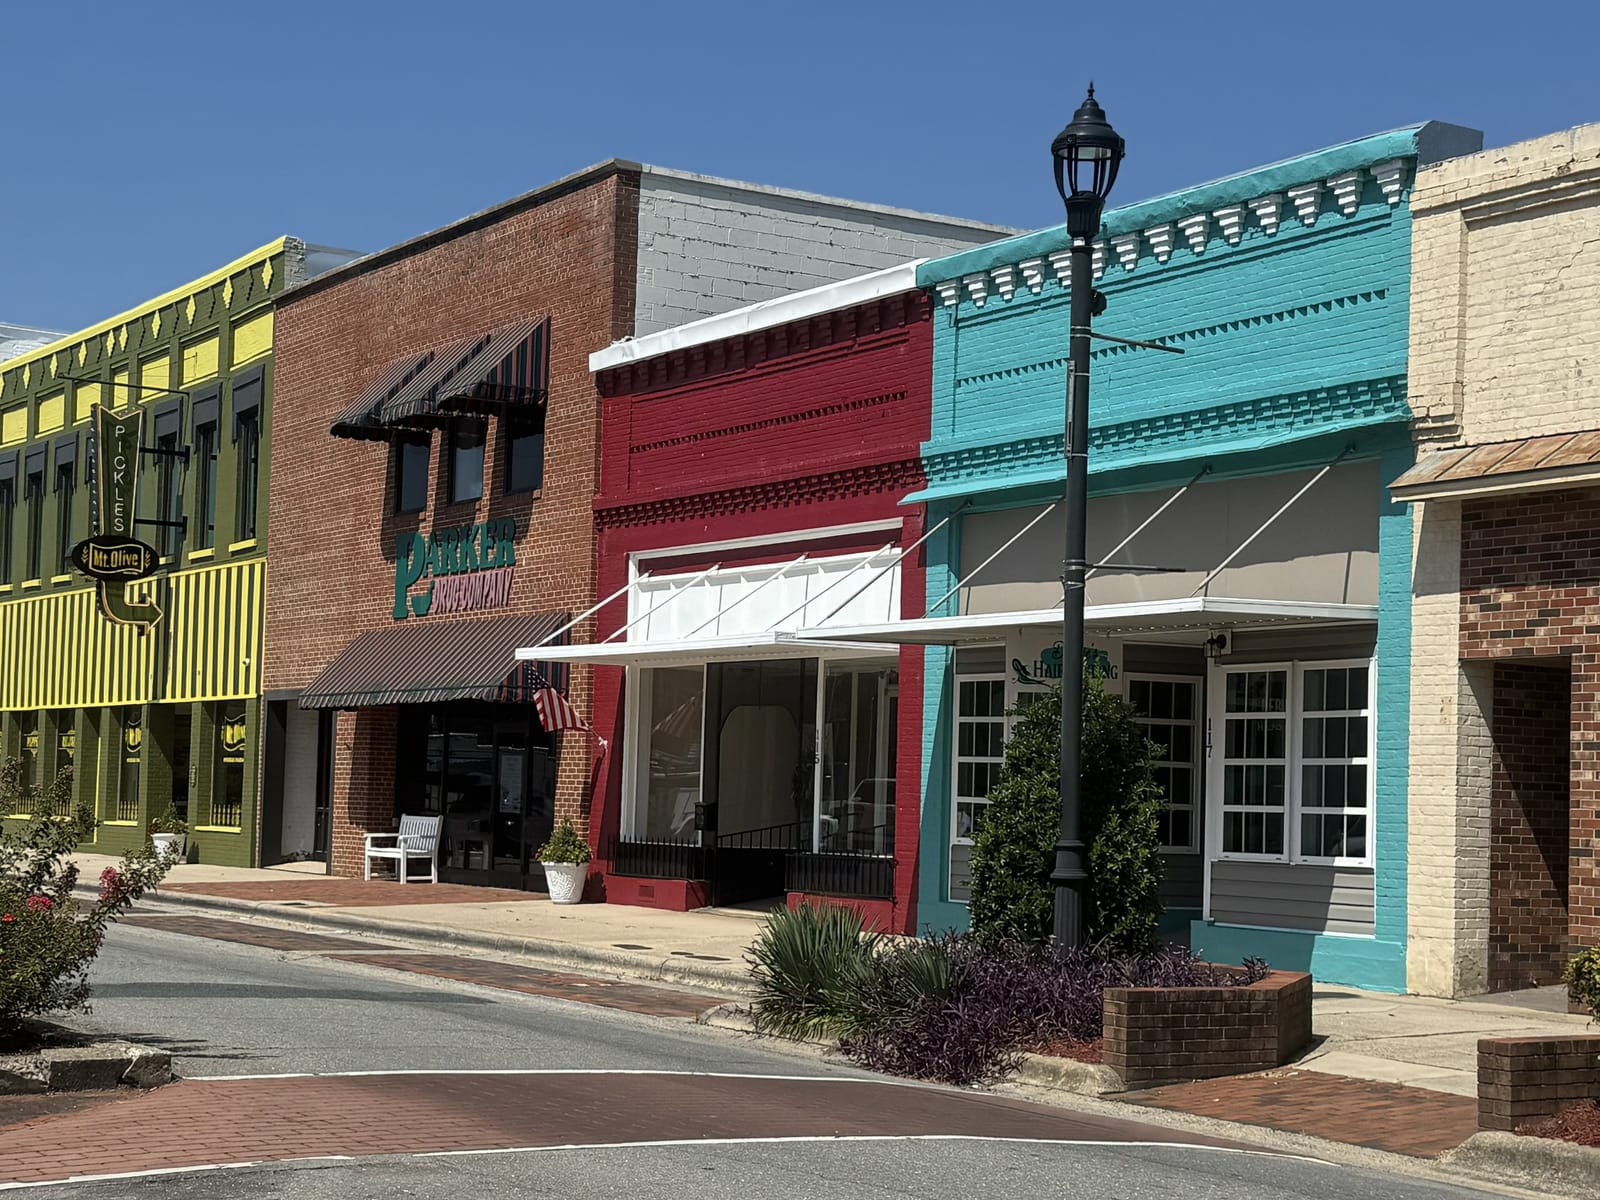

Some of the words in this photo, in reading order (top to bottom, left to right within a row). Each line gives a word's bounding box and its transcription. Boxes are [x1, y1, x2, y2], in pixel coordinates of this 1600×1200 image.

[113, 425, 126, 532] PICKLES
[93, 549, 110, 569] Mt.
[110, 549, 139, 568] Olive
[392, 518, 516, 619] PARKER
